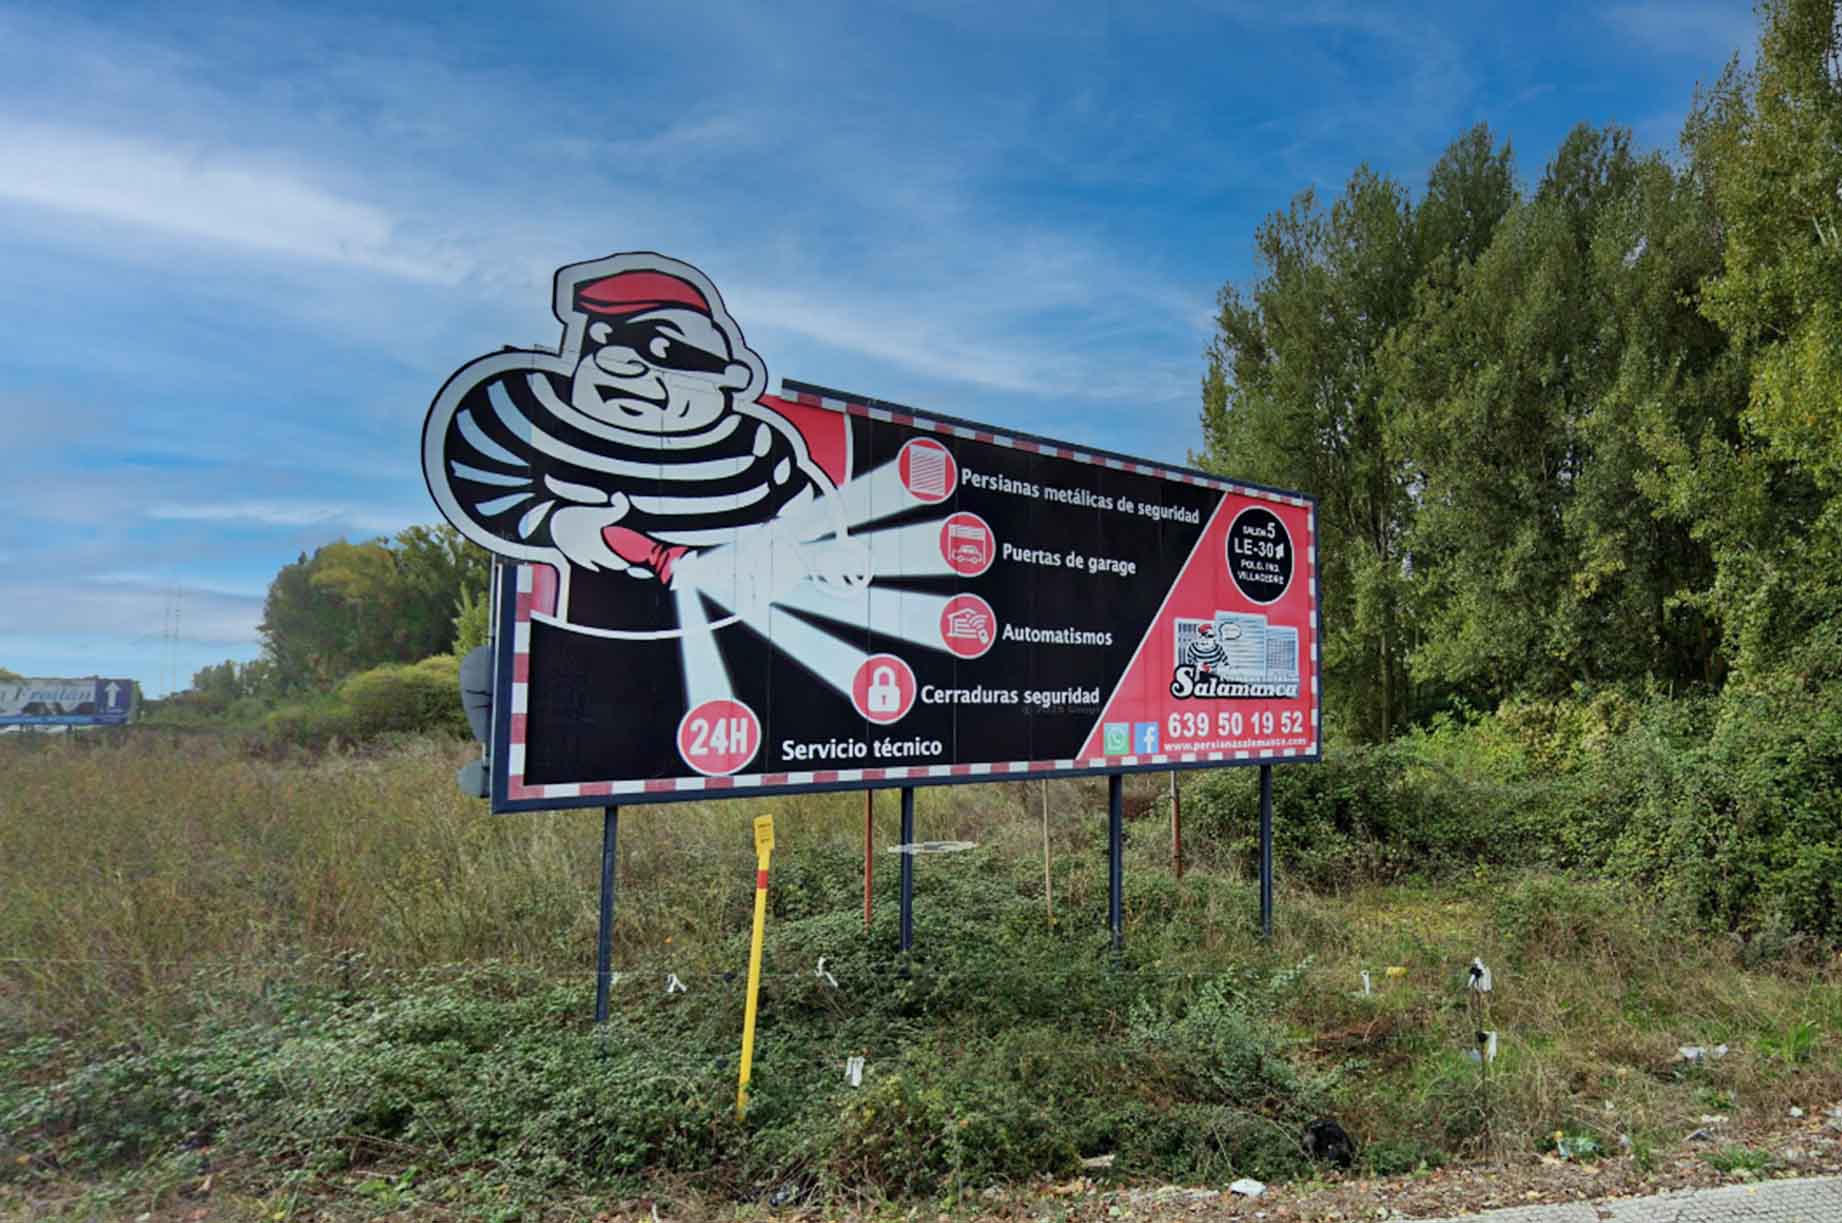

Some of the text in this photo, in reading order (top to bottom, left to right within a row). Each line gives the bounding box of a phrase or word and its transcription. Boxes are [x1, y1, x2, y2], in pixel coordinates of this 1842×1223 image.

[961, 468, 1200, 525] Persianas metálicas de seguridad
[1267, 522, 1276, 539] 5
[1002, 543, 1136, 577] Puertas de garage
[1002, 623, 1113, 646] Automatismos
[1170, 665, 1299, 698] Salamanca
[920, 684, 1100, 709] Cerraduras seguridad
[689, 716, 749, 757] 24H
[1168, 710, 1303, 738] 639 50 19 52
[781, 736, 943, 761] Servicio técnico
